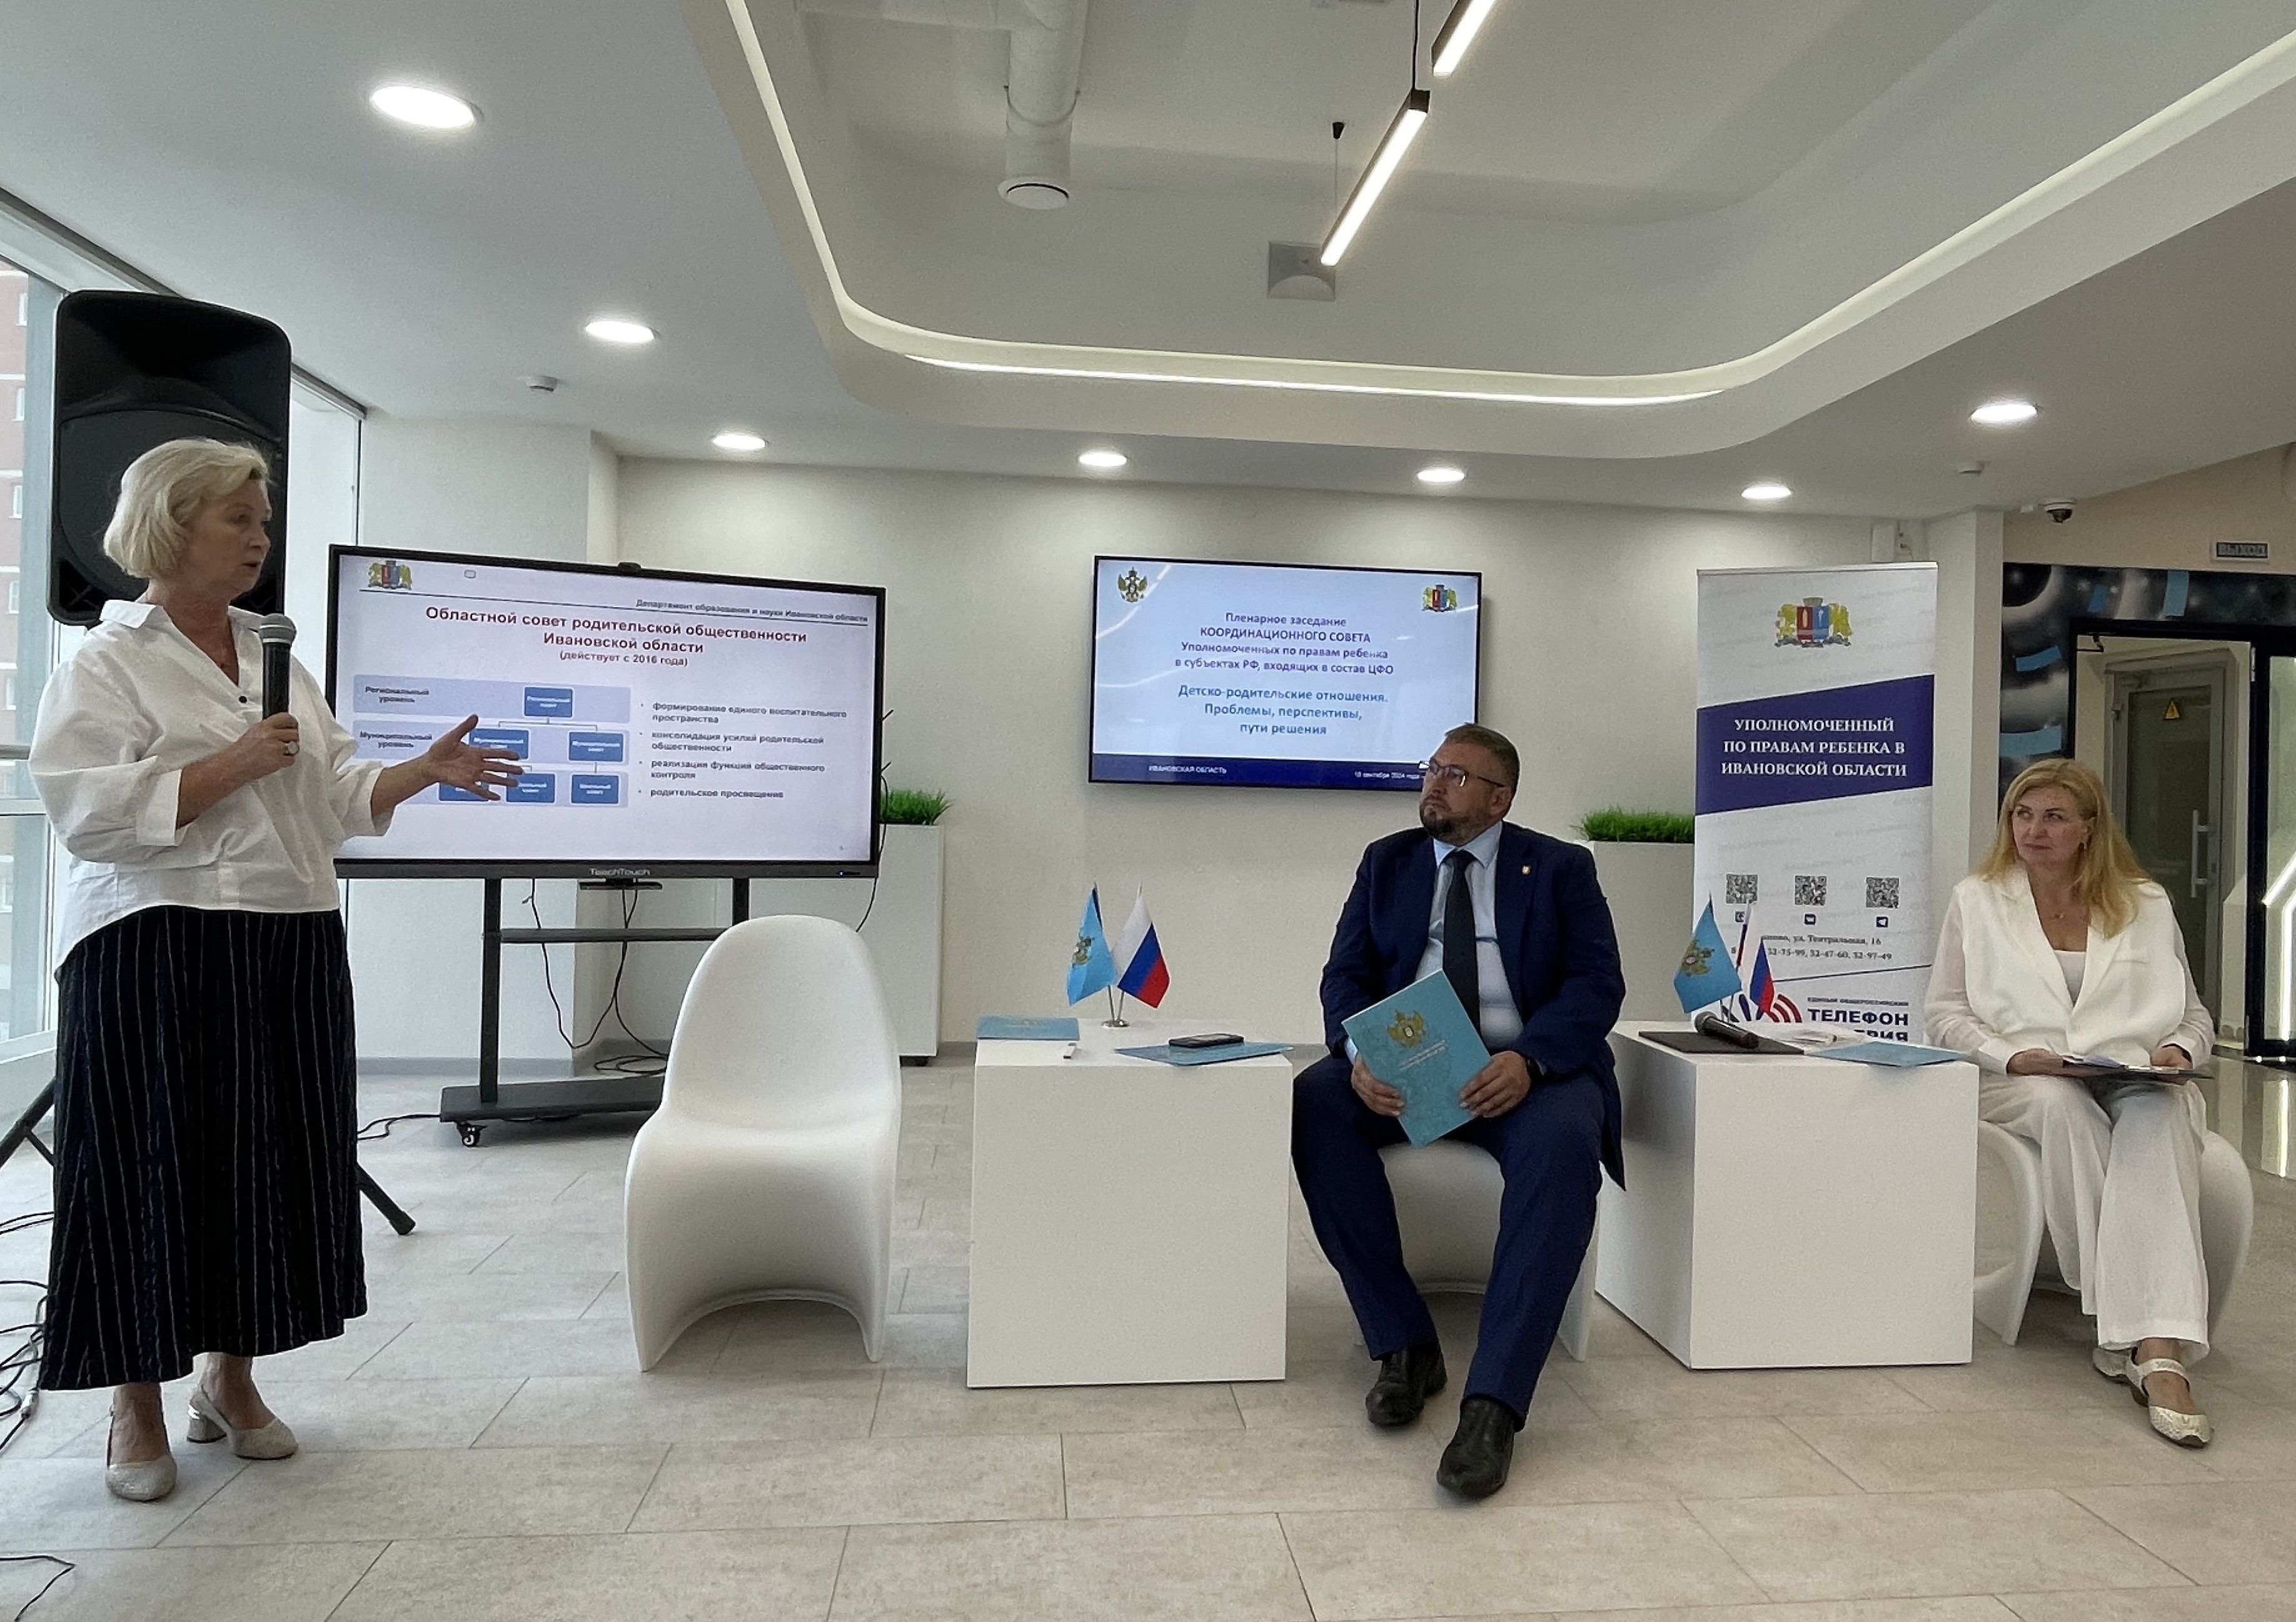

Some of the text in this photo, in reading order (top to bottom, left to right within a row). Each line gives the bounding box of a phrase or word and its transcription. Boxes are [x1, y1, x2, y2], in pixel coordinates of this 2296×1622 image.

[2218, 543, 2266, 557] ВЫХОД
[636, 599, 693, 609] Департамент
[695, 603, 750, 613] образования
[760, 609, 783, 617] науки
[785, 610, 833, 620] Ивановской
[835, 613, 869, 622] области
[426, 607, 807, 643] Областной совет родительской общественности
[1226, 612, 1347, 628] Пленарное заседание
[543, 632, 704, 653] Ивановской области
[1200, 627, 1371, 643] КООРДИНАЦИОННОГО СОВЕТА
[1181, 641, 1388, 659] Уполномоченных по правам ребенка
[559, 650, 620, 664] (действует
[632, 654, 658, 665] 2016
[660, 657, 688, 668] года)
[1175, 658, 1181, 667] в
[1184, 657, 1241, 669] субъектах
[1243, 659, 1261, 672] РФ,
[1264, 663, 1318, 673] входящих
[1331, 664, 1366, 673] состав
[1368, 664, 1394, 675] ЦФО
[1177, 684, 1388, 702] Детско-родительские отношения.
[652, 703, 727, 712] формирование
[769, 708, 847, 718] воспитательного
[1204, 703, 1362, 720] Проблемы, перспективы,
[652, 715, 719, 724] пространства
[1735, 717, 1895, 733] УПОЛНОМОЧЕННЫЙ
[1239, 723, 1327, 735] пути решения
[652, 732, 825, 744] консолидация усилий родительской
[652, 742, 732, 751] общественности
[1723, 740, 1905, 755] ПО ПРАВАМ РЕБЕНКА В
[651, 760, 825, 772] реализация функций общественного
[1721, 760, 1907, 777] ИВАНОВСКОЙ ОБЛАСТИ
[650, 772, 696, 780] контроля
[650, 789, 784, 799] родительское просвещение
[1808, 934, 1868, 945] Театральная,
[1807, 1007, 1909, 1025] ТЕЛЕФОН
